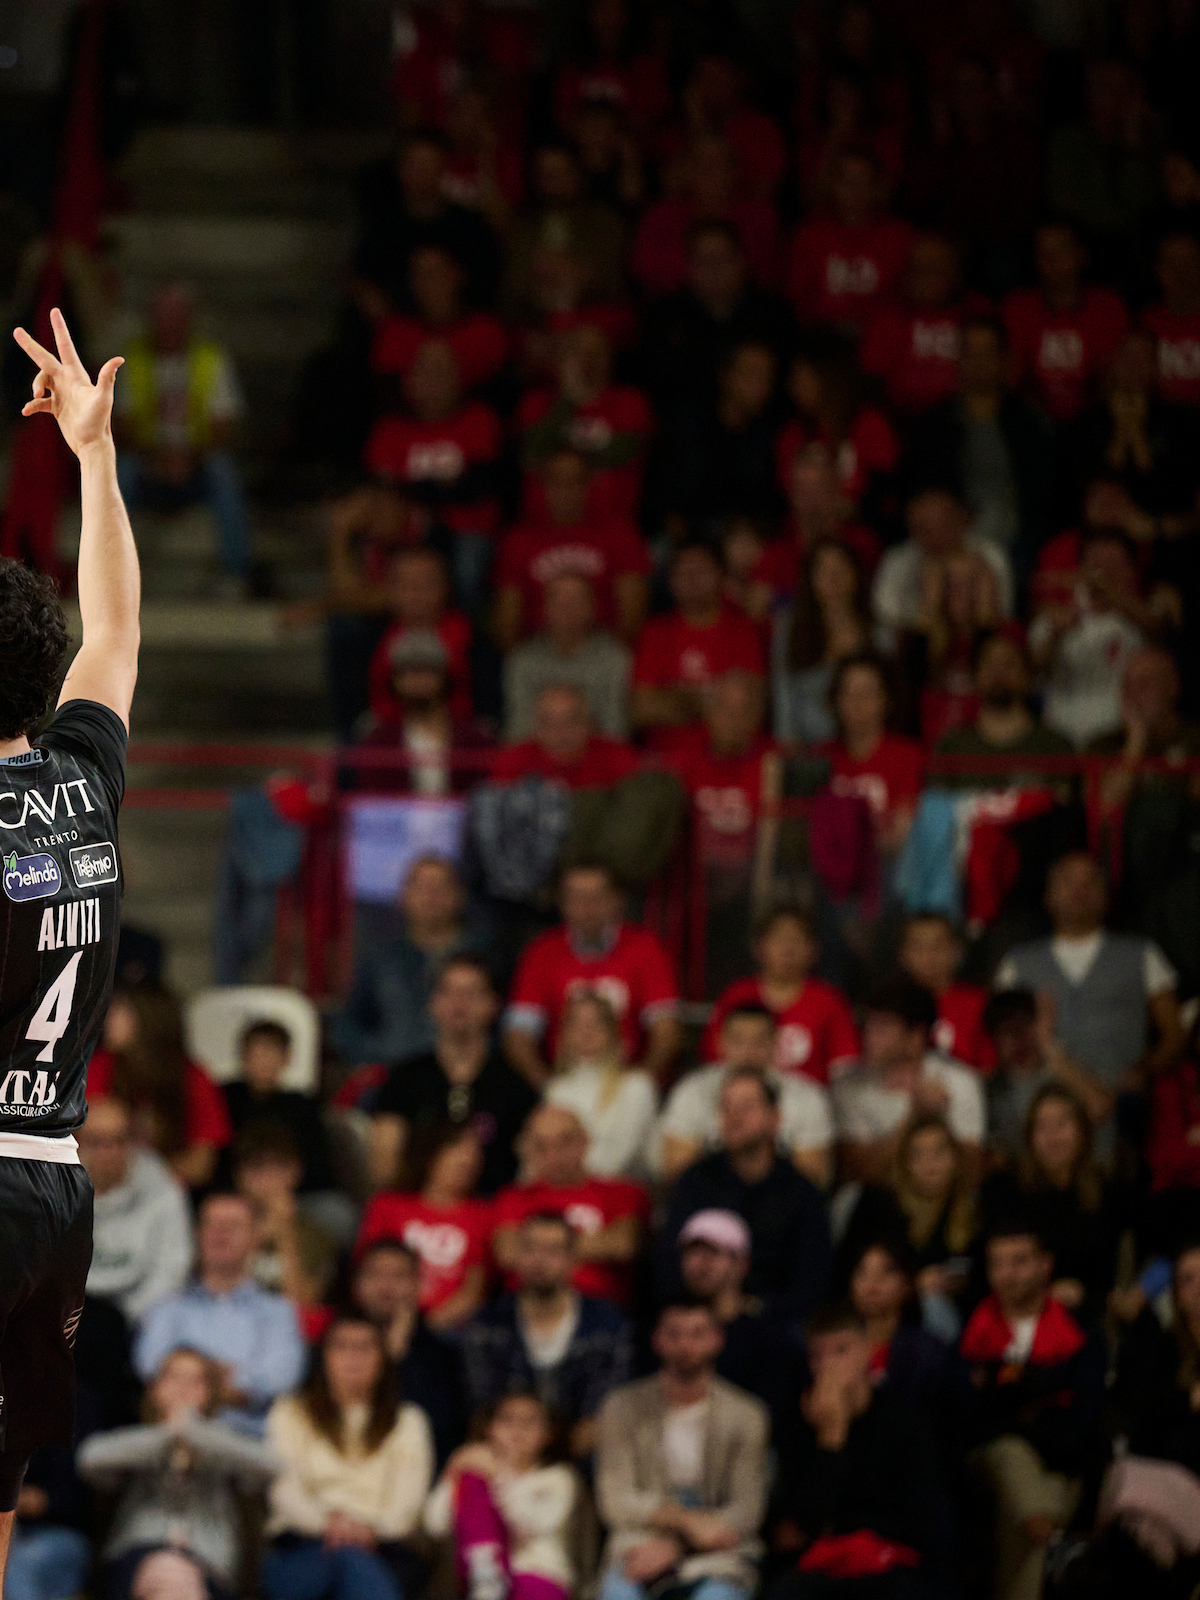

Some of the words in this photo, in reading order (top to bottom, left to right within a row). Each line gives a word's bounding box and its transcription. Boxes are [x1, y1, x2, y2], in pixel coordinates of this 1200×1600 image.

[34, 830, 78, 848] TRENTO
[6, 862, 58, 889] Melinda
[38, 898, 100, 951] ALVITI
[25, 950, 83, 1063] 4
